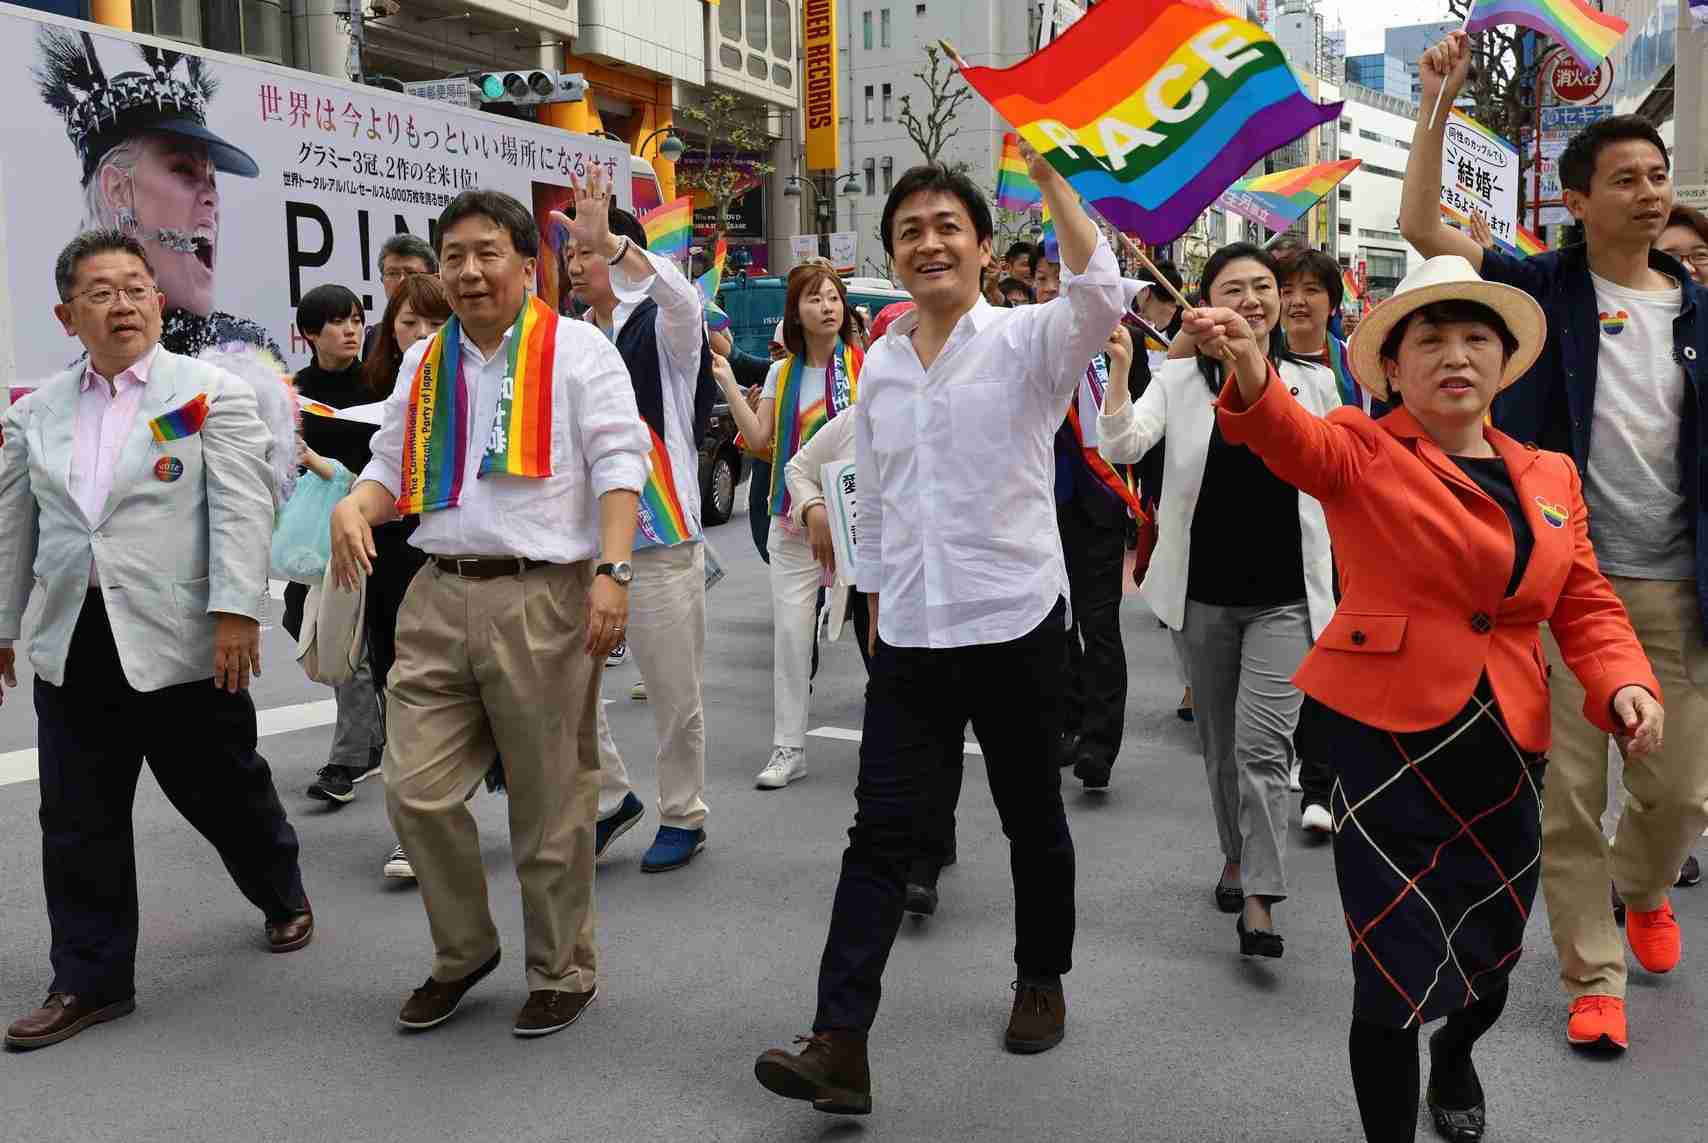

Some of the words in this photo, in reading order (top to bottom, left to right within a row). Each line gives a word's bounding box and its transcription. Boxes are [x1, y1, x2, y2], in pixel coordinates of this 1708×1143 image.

[807, 43, 831, 130] RECORDS
[1456, 156, 1492, 200] 結婚
[422, 362, 433, 391] Japan
[422, 394, 432, 405] of
[421, 407, 432, 434] Party
[410, 477, 418, 496] The
